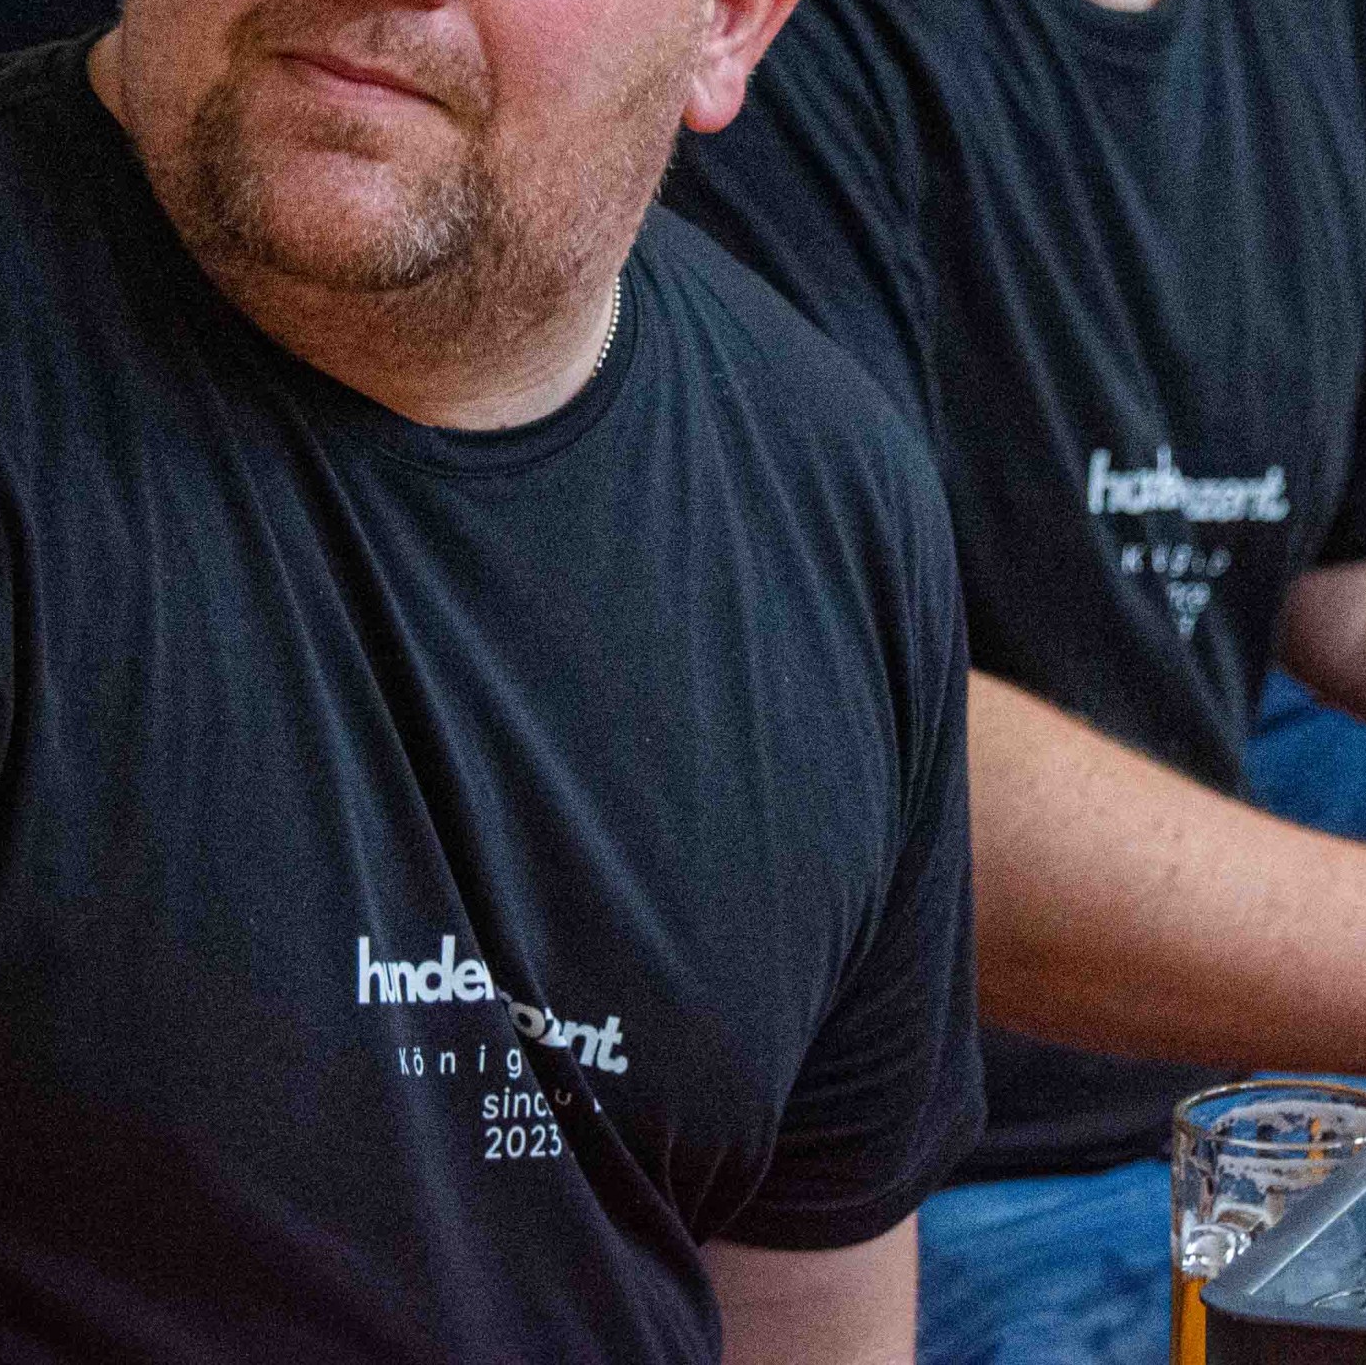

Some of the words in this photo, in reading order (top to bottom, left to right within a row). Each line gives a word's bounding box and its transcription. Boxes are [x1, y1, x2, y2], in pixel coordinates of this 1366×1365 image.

[398, 1044, 523, 1079] König
[482, 1086, 554, 1120] sinc
[484, 1123, 563, 1160] 2023
